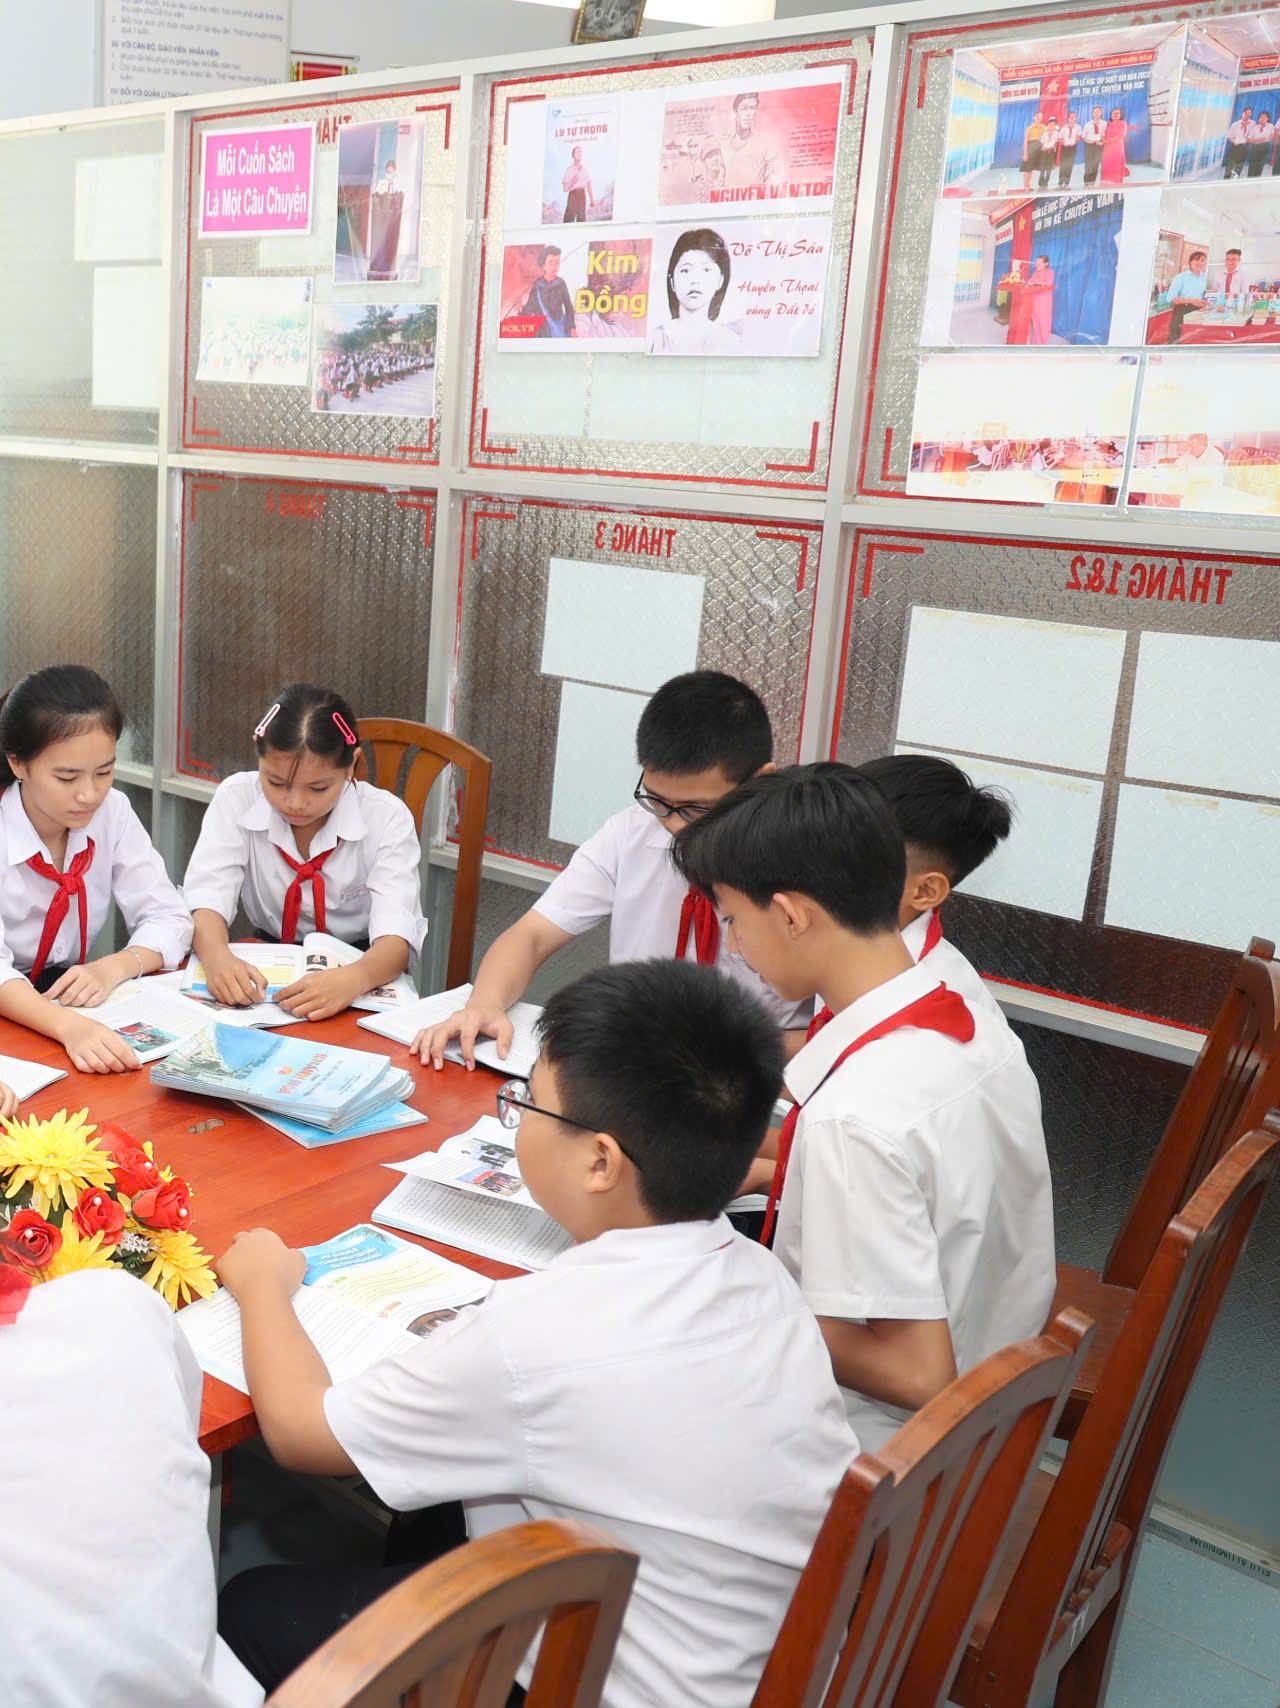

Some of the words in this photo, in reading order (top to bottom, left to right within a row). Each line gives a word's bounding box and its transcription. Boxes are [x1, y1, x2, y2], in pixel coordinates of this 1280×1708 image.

[216, 143, 237, 177] Mỗi
[238, 139, 266, 176] Cuốn
[268, 144, 295, 174] Sách
[206, 188, 221, 217] Là
[222, 187, 242, 223] Một
[244, 186, 265, 216] Câu
[267, 184, 307, 222] Chuyện
[588, 250, 639, 276] Kim
[575, 284, 649, 320] Đồng
